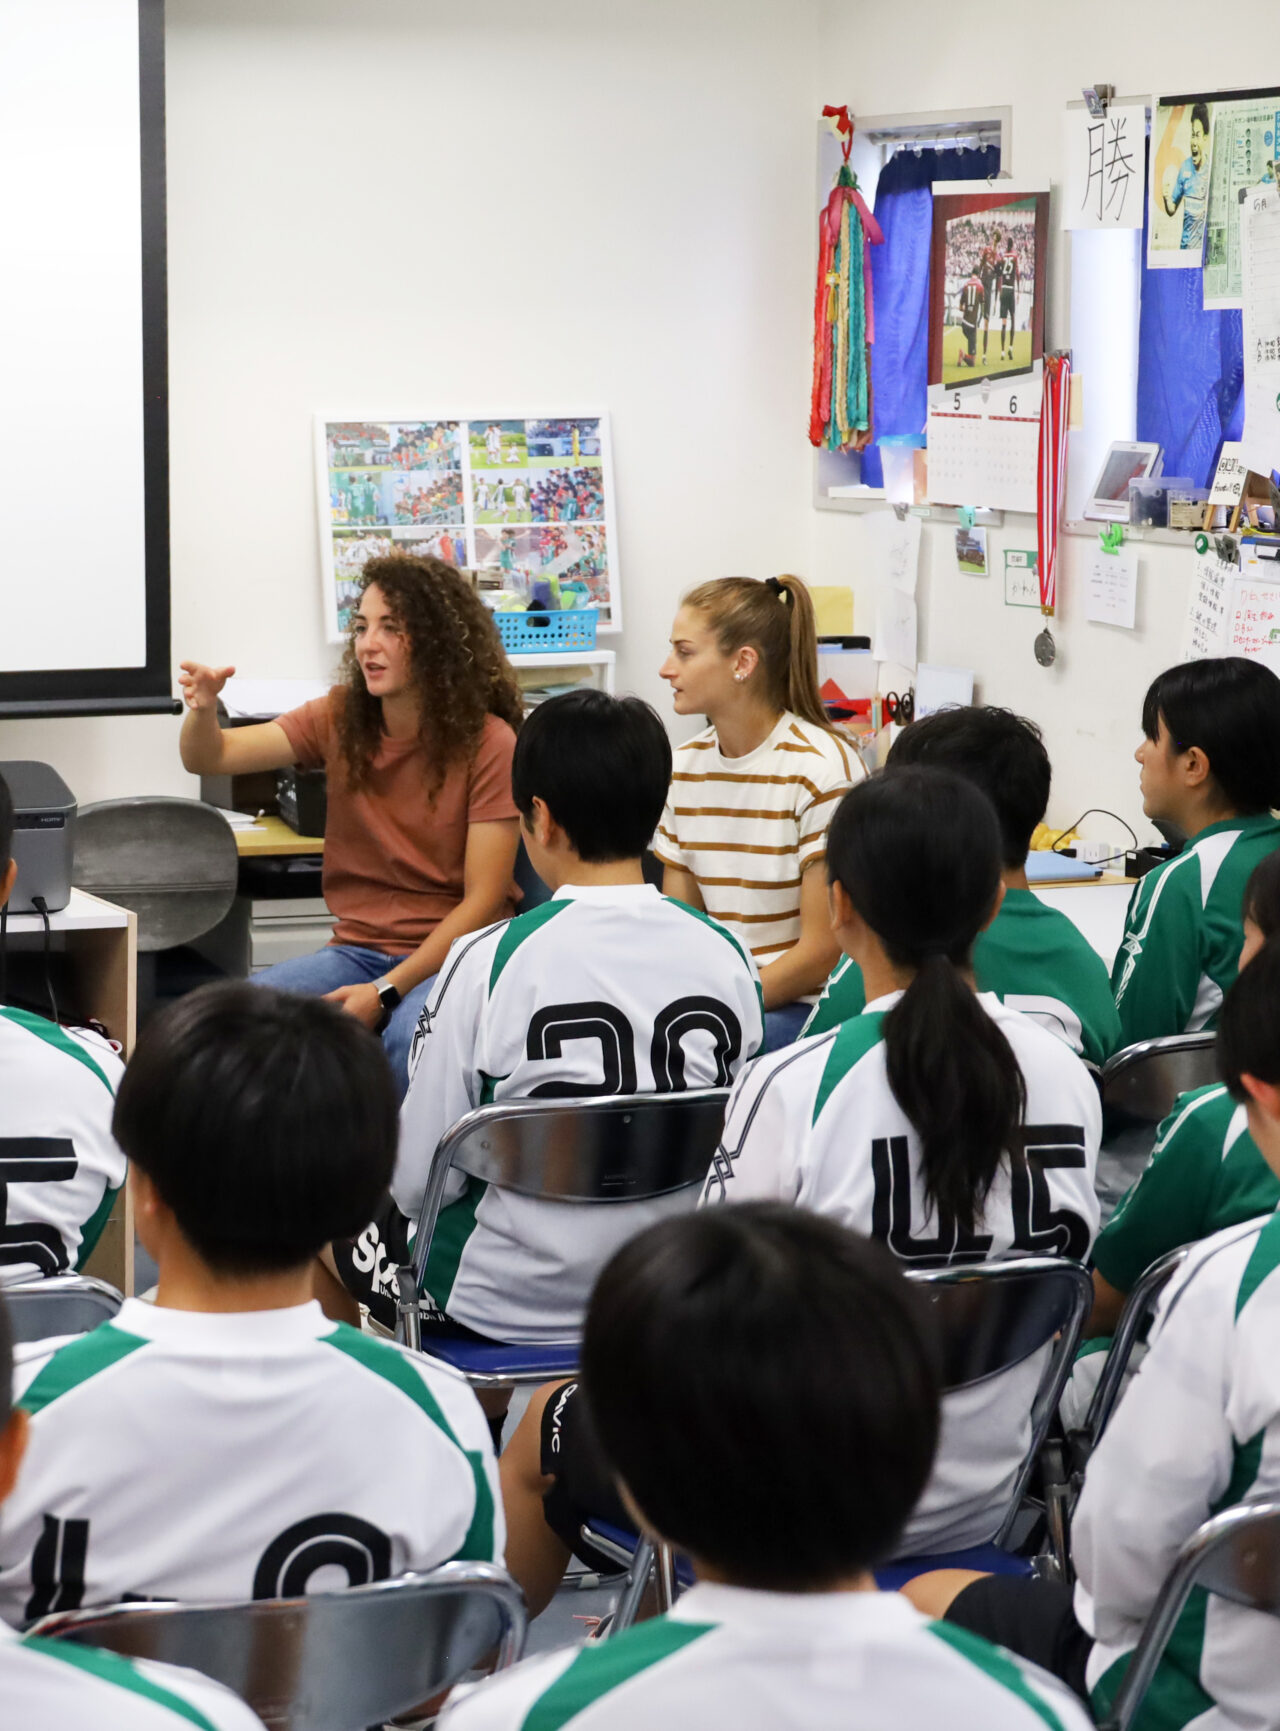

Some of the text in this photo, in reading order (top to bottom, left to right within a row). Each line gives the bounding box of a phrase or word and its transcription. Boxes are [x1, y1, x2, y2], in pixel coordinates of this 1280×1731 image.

[1081, 116, 1135, 221] 勝
[1002, 256, 1014, 275] 25
[967, 285, 977, 306] 11
[953, 392, 961, 410] 5
[1009, 395, 1018, 414] 6
